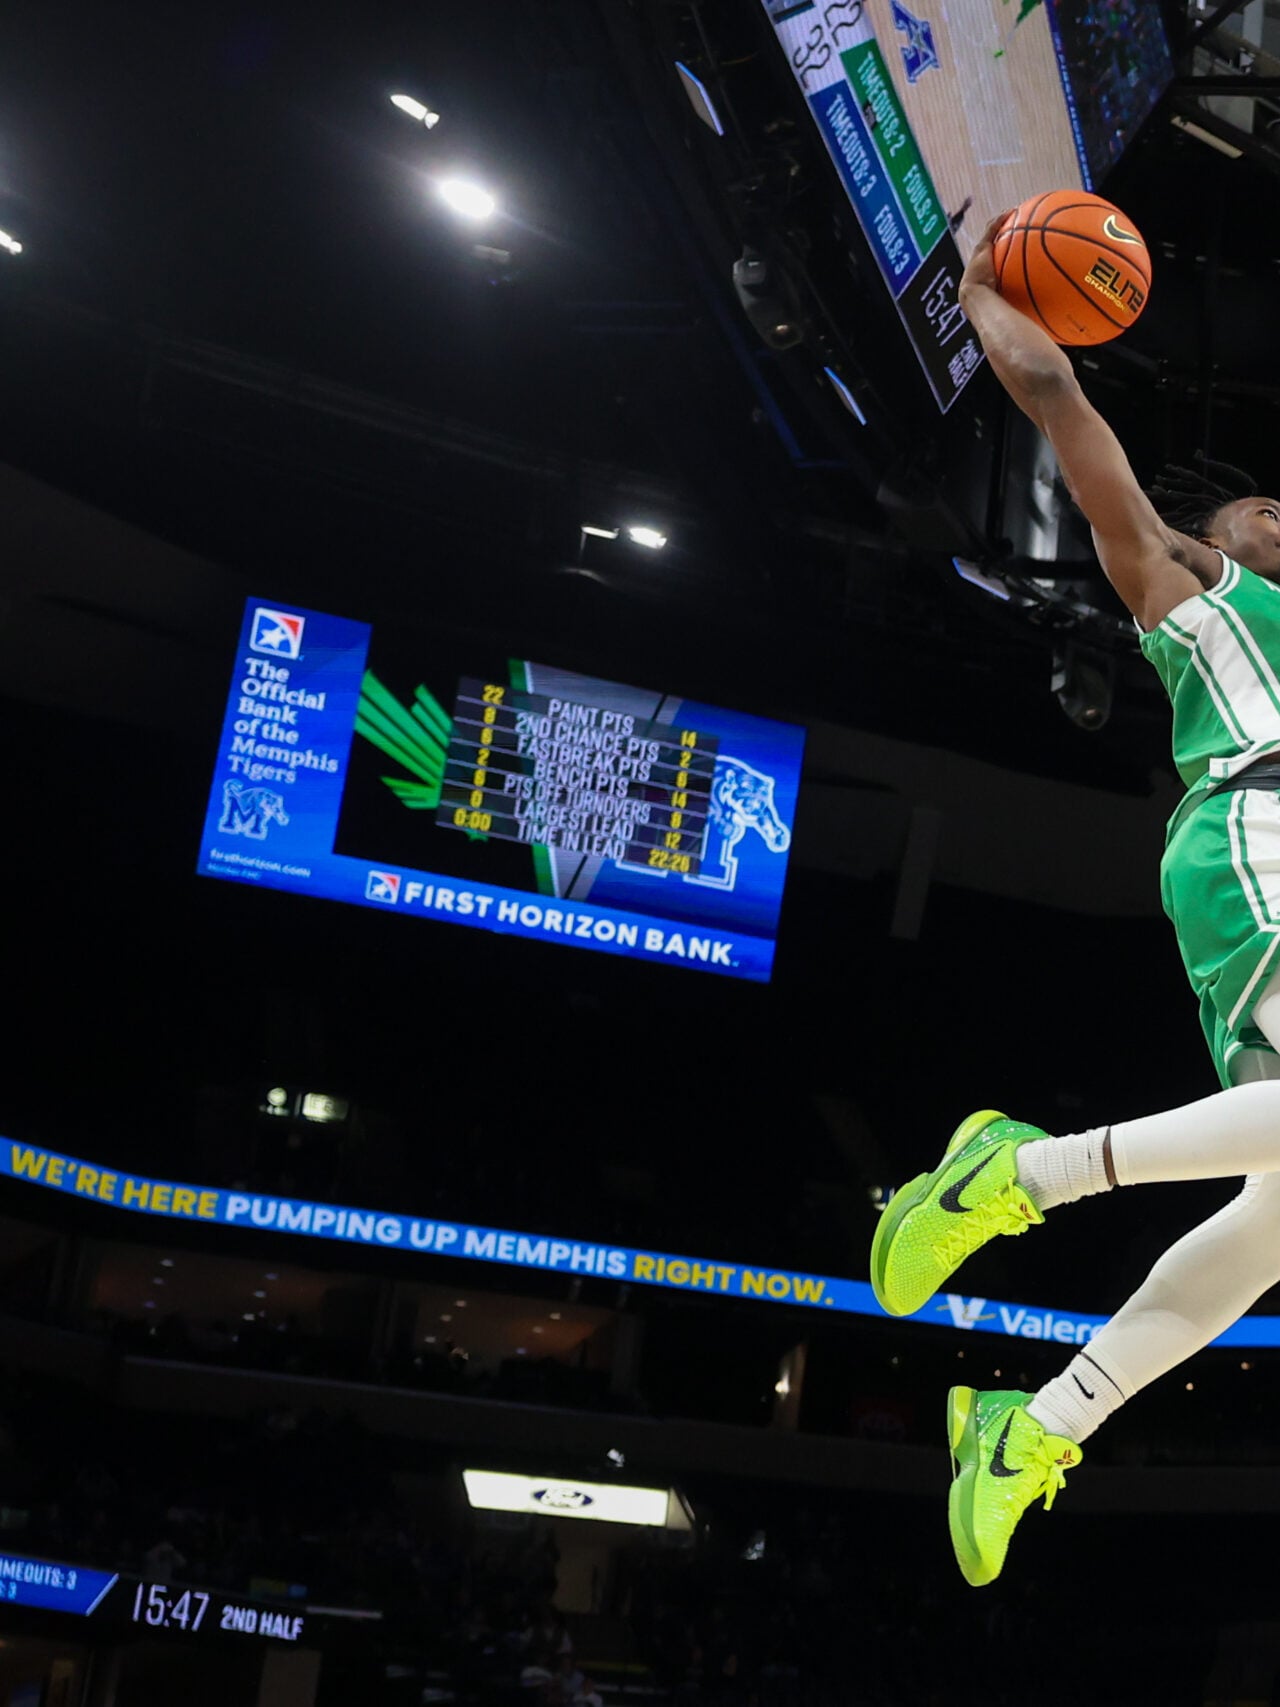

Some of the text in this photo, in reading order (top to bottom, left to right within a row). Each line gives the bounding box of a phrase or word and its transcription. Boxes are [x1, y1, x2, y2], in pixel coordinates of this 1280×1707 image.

[793, 24, 831, 89] 32
[857, 51, 906, 157] TIMEOUTS: 2
[826, 93, 877, 198] TIMEOUTS: 3
[902, 164, 938, 235] FOULS: 0
[873, 204, 910, 276] FOULS: 3
[921, 266, 968, 347] 15:47
[1090, 256, 1145, 314] ELITE
[948, 352, 969, 389] HALF
[241, 678, 326, 711] Official
[245, 657, 290, 684] The
[234, 719, 299, 745] of the
[238, 697, 298, 725] Bank
[483, 685, 697, 749] 22 PAINT PTS 14
[227, 754, 296, 784] Tigers
[232, 736, 339, 773] Memphis
[515, 713, 551, 737] 2ND
[554, 722, 625, 754] CHANCE
[628, 739, 660, 763] PTS
[679, 751, 692, 769] 2
[517, 735, 617, 776] FASTBREAK
[619, 758, 652, 783] PTS
[477, 748, 687, 809] 2 BENCH PTS 14
[504, 774, 534, 798] PTS
[535, 782, 562, 803] OFF
[566, 788, 651, 825] TURNOVERS
[454, 808, 492, 832] 0:00
[517, 820, 557, 845] TIME
[560, 829, 580, 850] IN
[583, 836, 624, 861] LEAD
[514, 800, 588, 830] LARGEST
[592, 817, 634, 842] LEAD
[665, 831, 681, 850] 12
[403, 881, 493, 919] FIRST
[497, 901, 639, 948] HORIZON
[10, 1145, 835, 1306] WE'RE HERE PUMPING UP MEMPHIS RIGHT NOW.
[0, 1557, 77, 1590] IMEOUTS: 3
[132, 1581, 304, 1641] 15:47 2ND HALF
